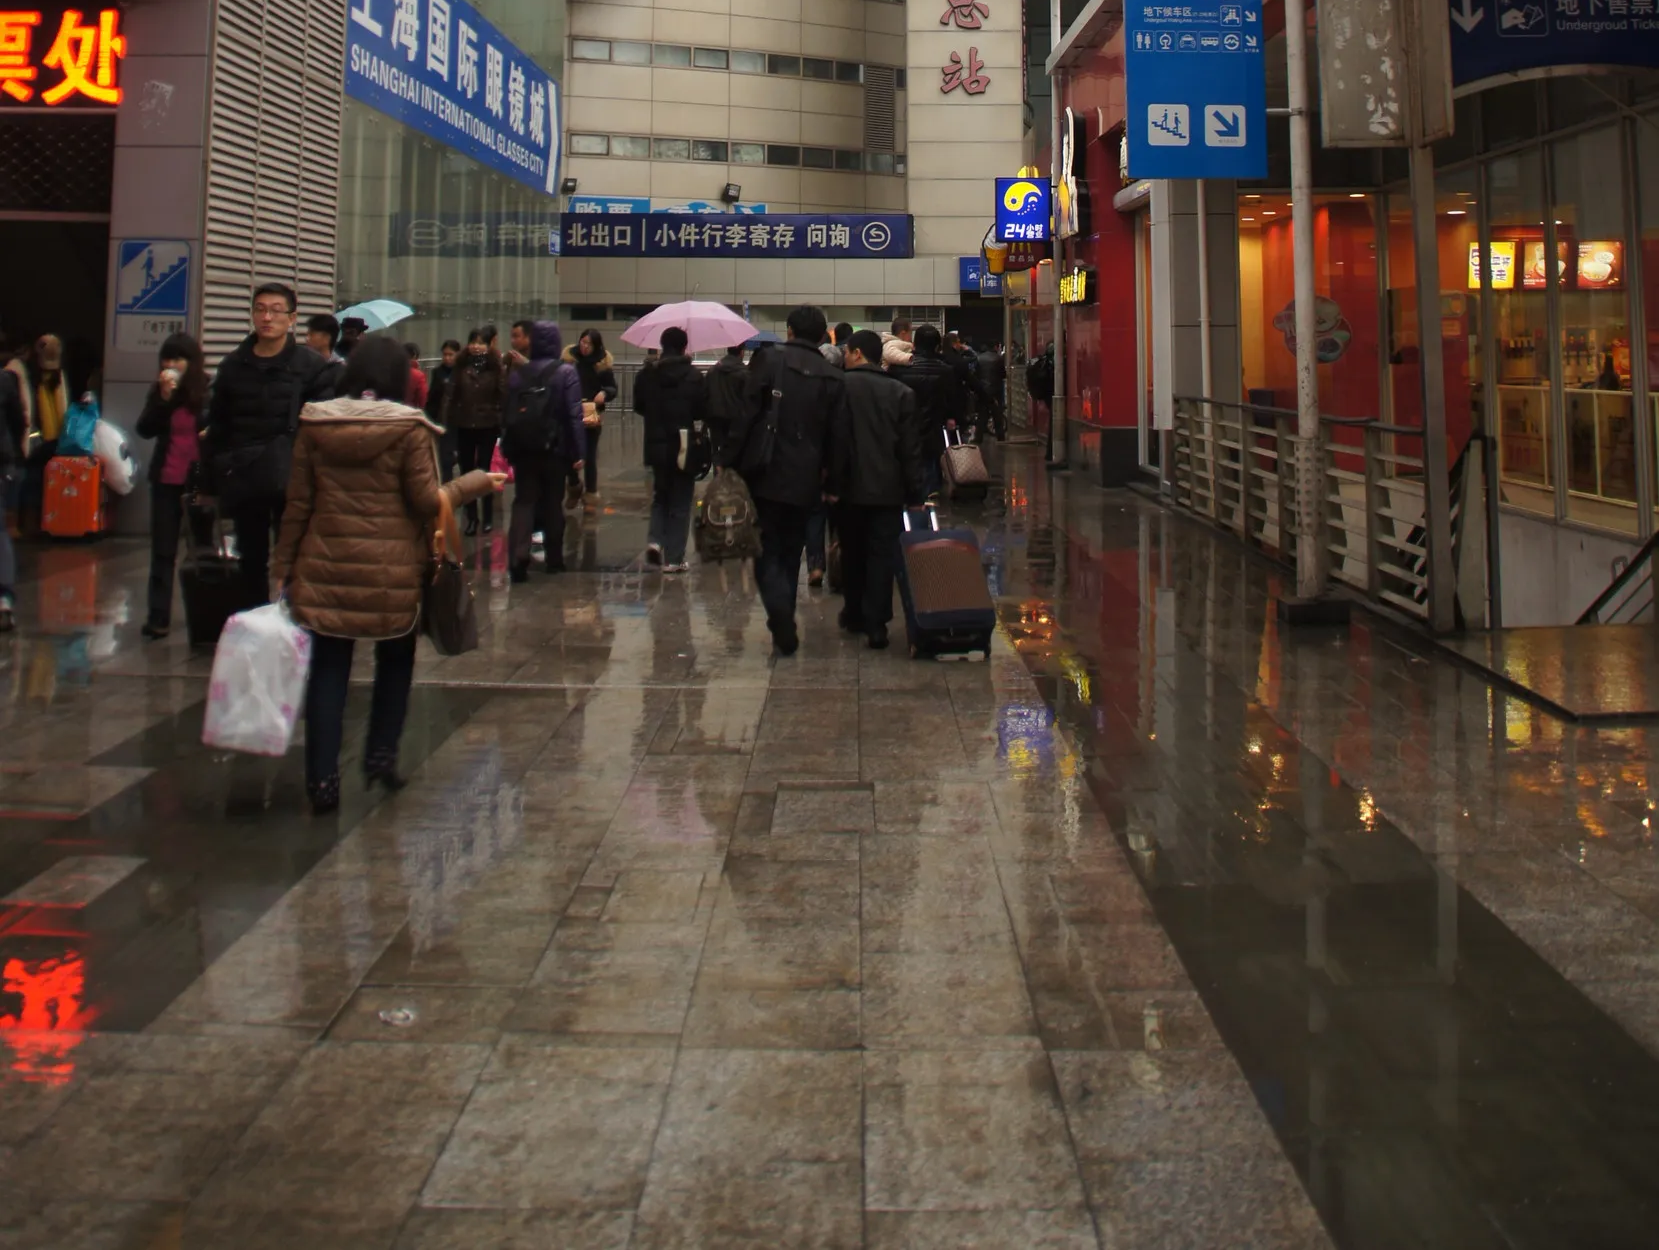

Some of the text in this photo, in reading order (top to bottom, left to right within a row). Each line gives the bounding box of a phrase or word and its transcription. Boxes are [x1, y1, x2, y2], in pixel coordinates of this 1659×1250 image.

[1143, 6, 1192, 18] 地下候车区
[351, 43, 545, 177] SHANGHAI INTERNATIONAL GLASSES CITY
[567, 222, 632, 248] 北出口
[654, 222, 796, 249] 小件行李寄存
[807, 222, 851, 249] 问询
